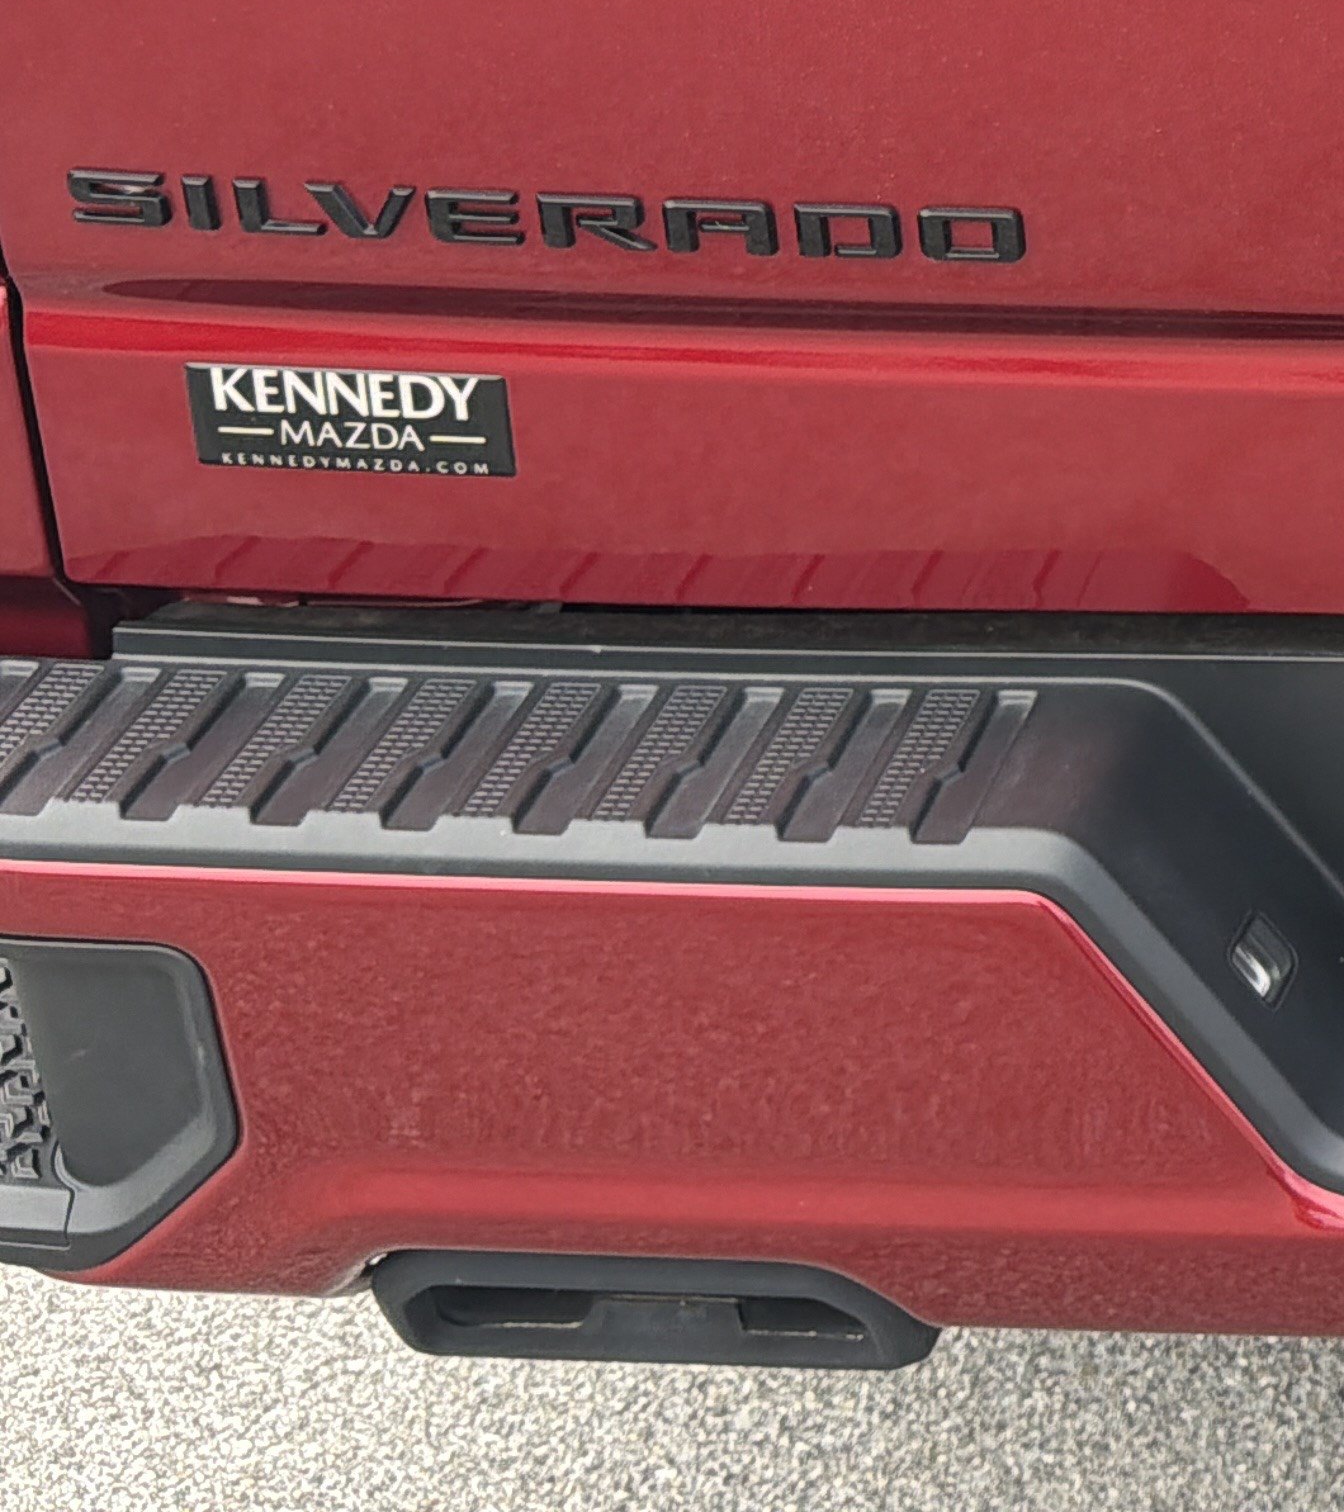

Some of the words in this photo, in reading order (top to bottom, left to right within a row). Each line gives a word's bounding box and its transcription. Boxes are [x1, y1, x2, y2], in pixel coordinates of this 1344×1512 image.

[66, 166, 1028, 264] SILVERADO
[209, 366, 479, 421] KENNEDY
[279, 419, 425, 452] MAZDA
[221, 451, 490, 476] KENNEDYMAZDA.COM
